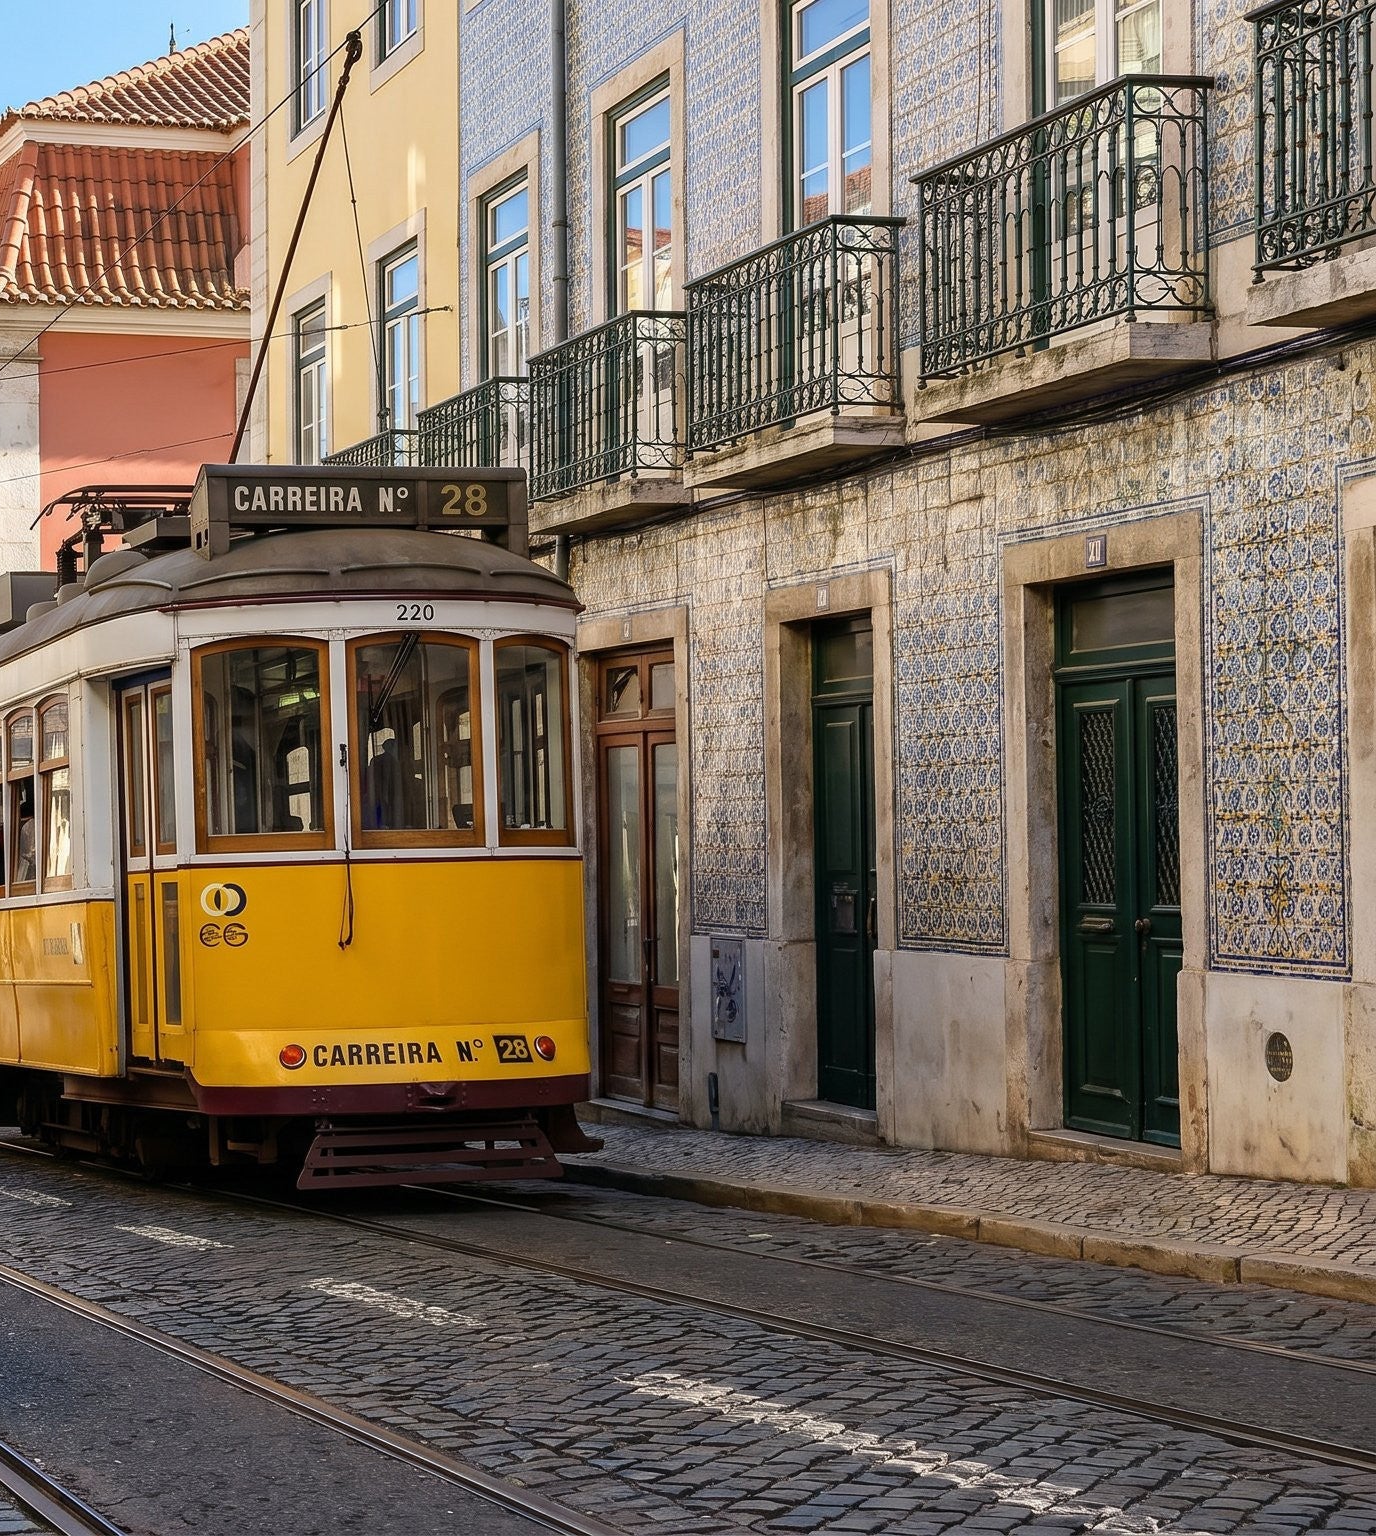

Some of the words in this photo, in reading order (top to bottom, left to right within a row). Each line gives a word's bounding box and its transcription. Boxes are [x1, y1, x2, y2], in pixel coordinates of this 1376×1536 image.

[235, 486, 363, 512] CARREIRA
[441, 484, 487, 516] 28
[397, 604, 434, 620] 220
[313, 1041, 443, 1067] CARREIRA
[499, 1039, 528, 1059] 28
